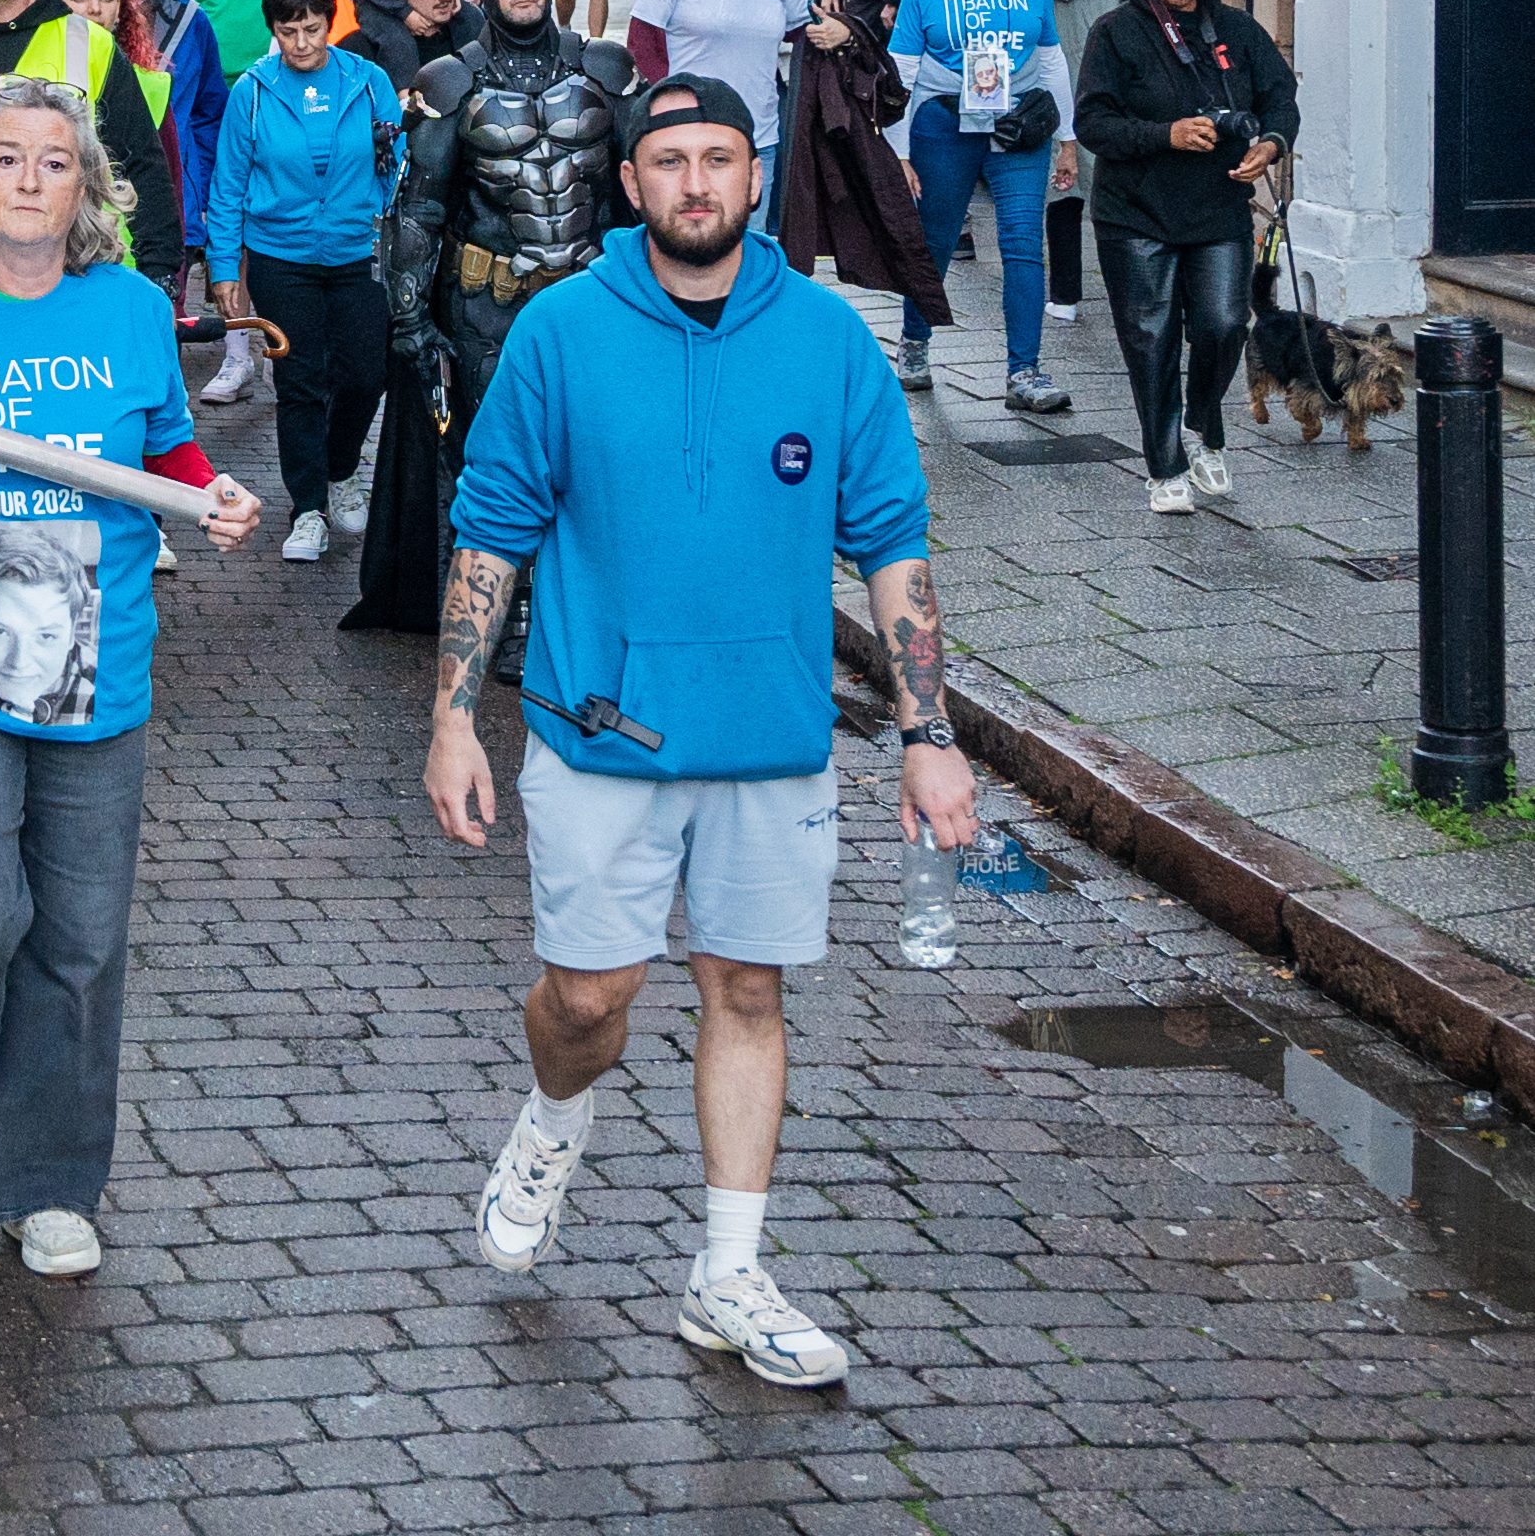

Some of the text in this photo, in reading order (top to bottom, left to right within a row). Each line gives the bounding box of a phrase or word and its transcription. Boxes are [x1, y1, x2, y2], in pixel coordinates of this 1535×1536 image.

[964, 11, 992, 30] OF
[966, 31, 1026, 51] HOPE
[31, 488, 84, 515] 2025
